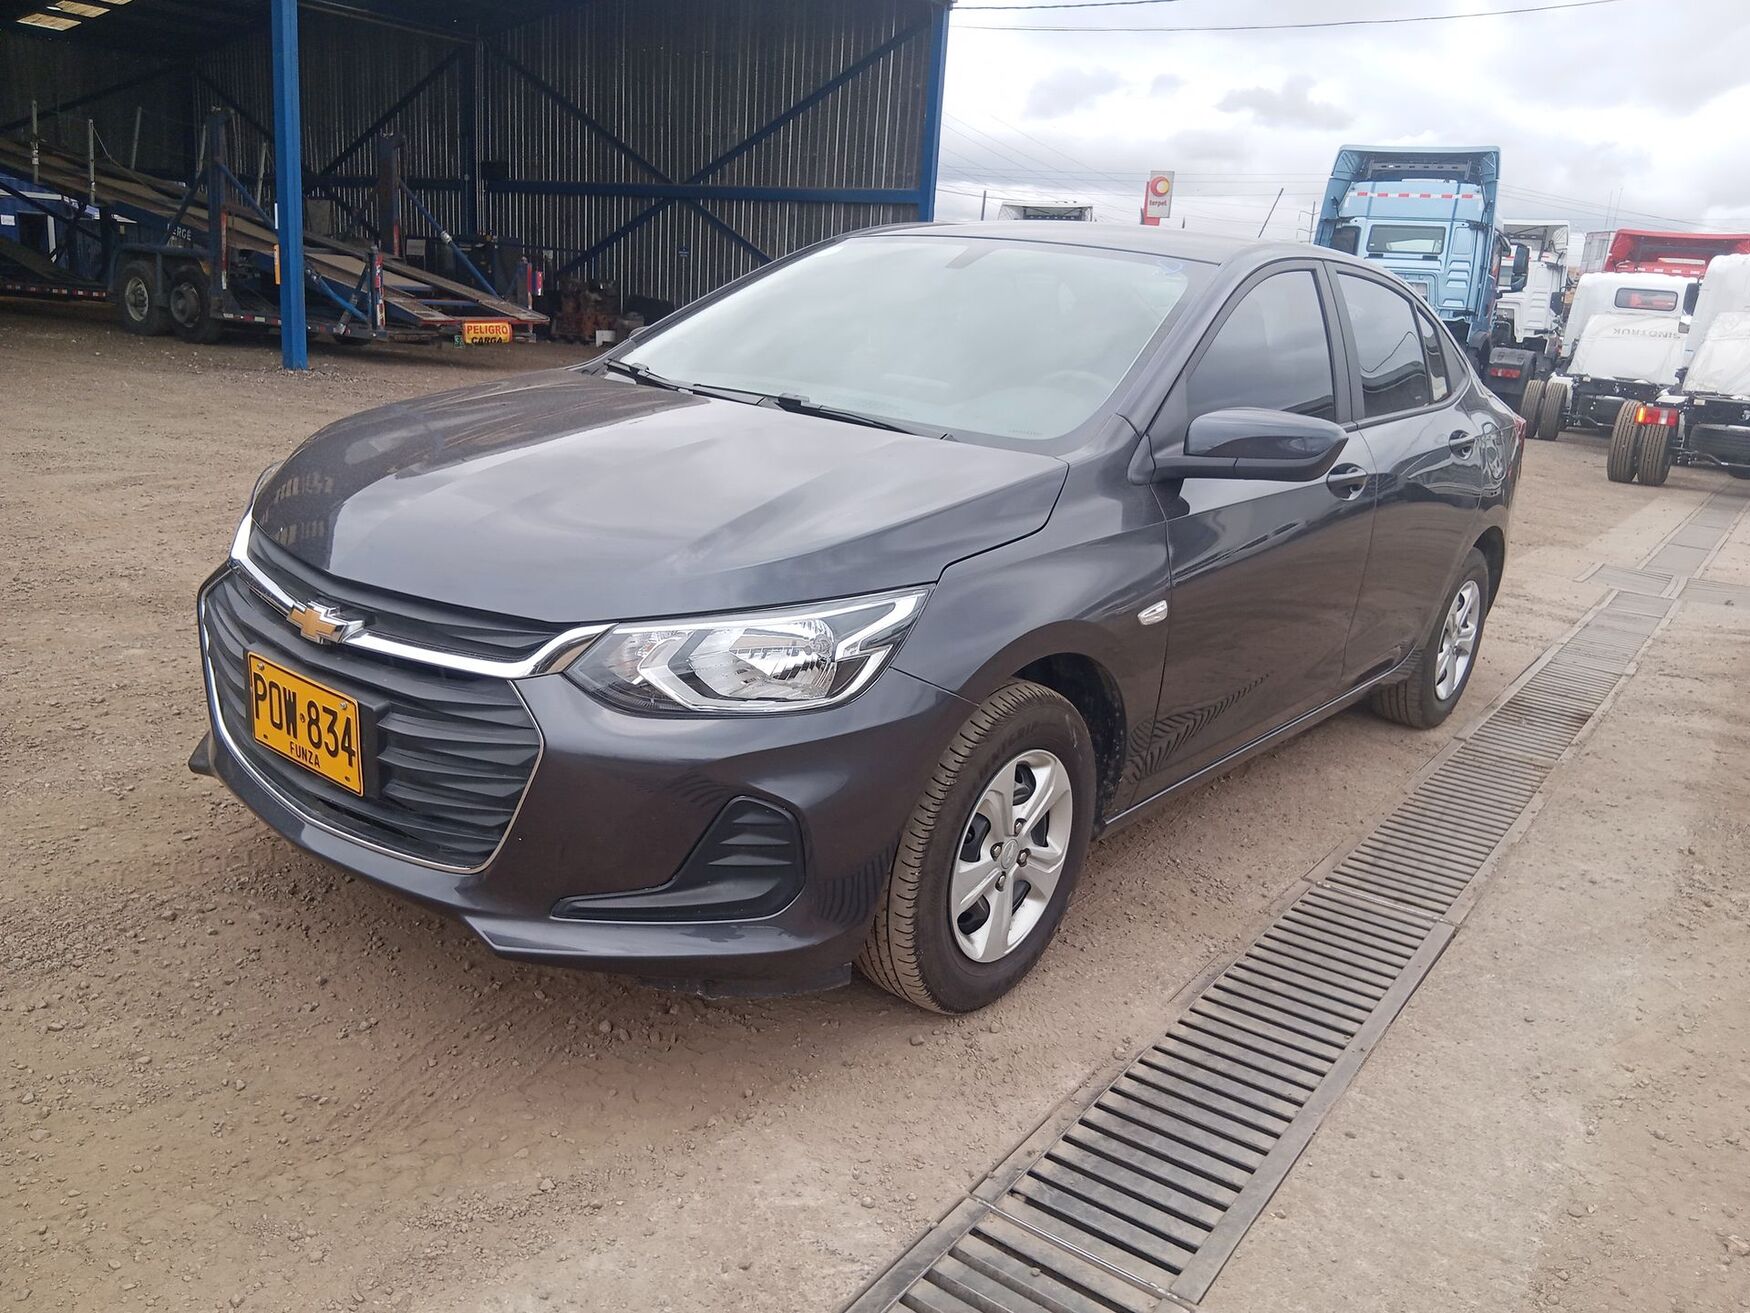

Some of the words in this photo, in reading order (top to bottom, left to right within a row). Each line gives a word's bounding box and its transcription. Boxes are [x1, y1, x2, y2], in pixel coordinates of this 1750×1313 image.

[466, 325, 508, 335] PELIGRO
[471, 336, 503, 344] CARGA
[289, 740, 321, 769] FUNZA
